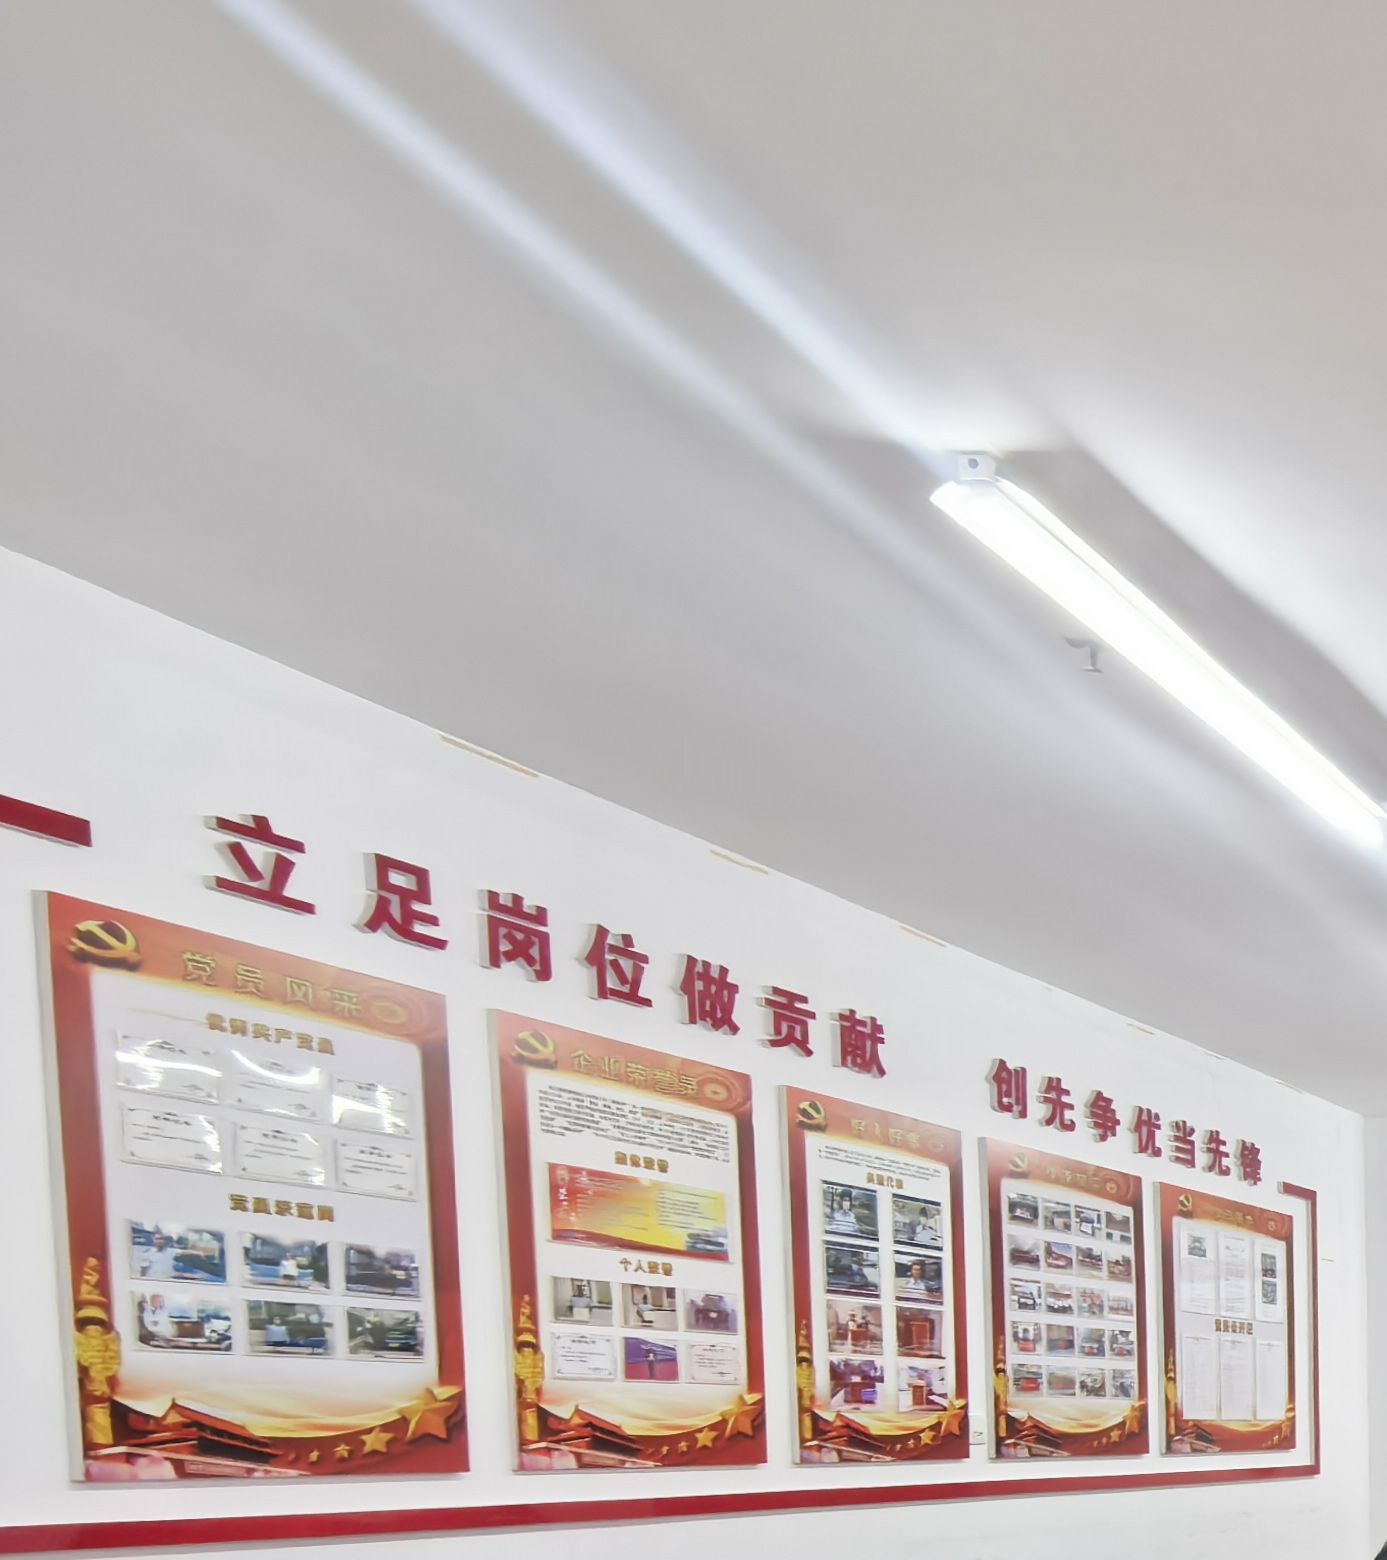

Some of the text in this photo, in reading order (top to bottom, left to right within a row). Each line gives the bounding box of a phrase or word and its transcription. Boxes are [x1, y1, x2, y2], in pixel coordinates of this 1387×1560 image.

[182, 950, 362, 1017] 党员风采
[206, 814, 1262, 1186] 立足岗位做贡献 创先争优当先锋
